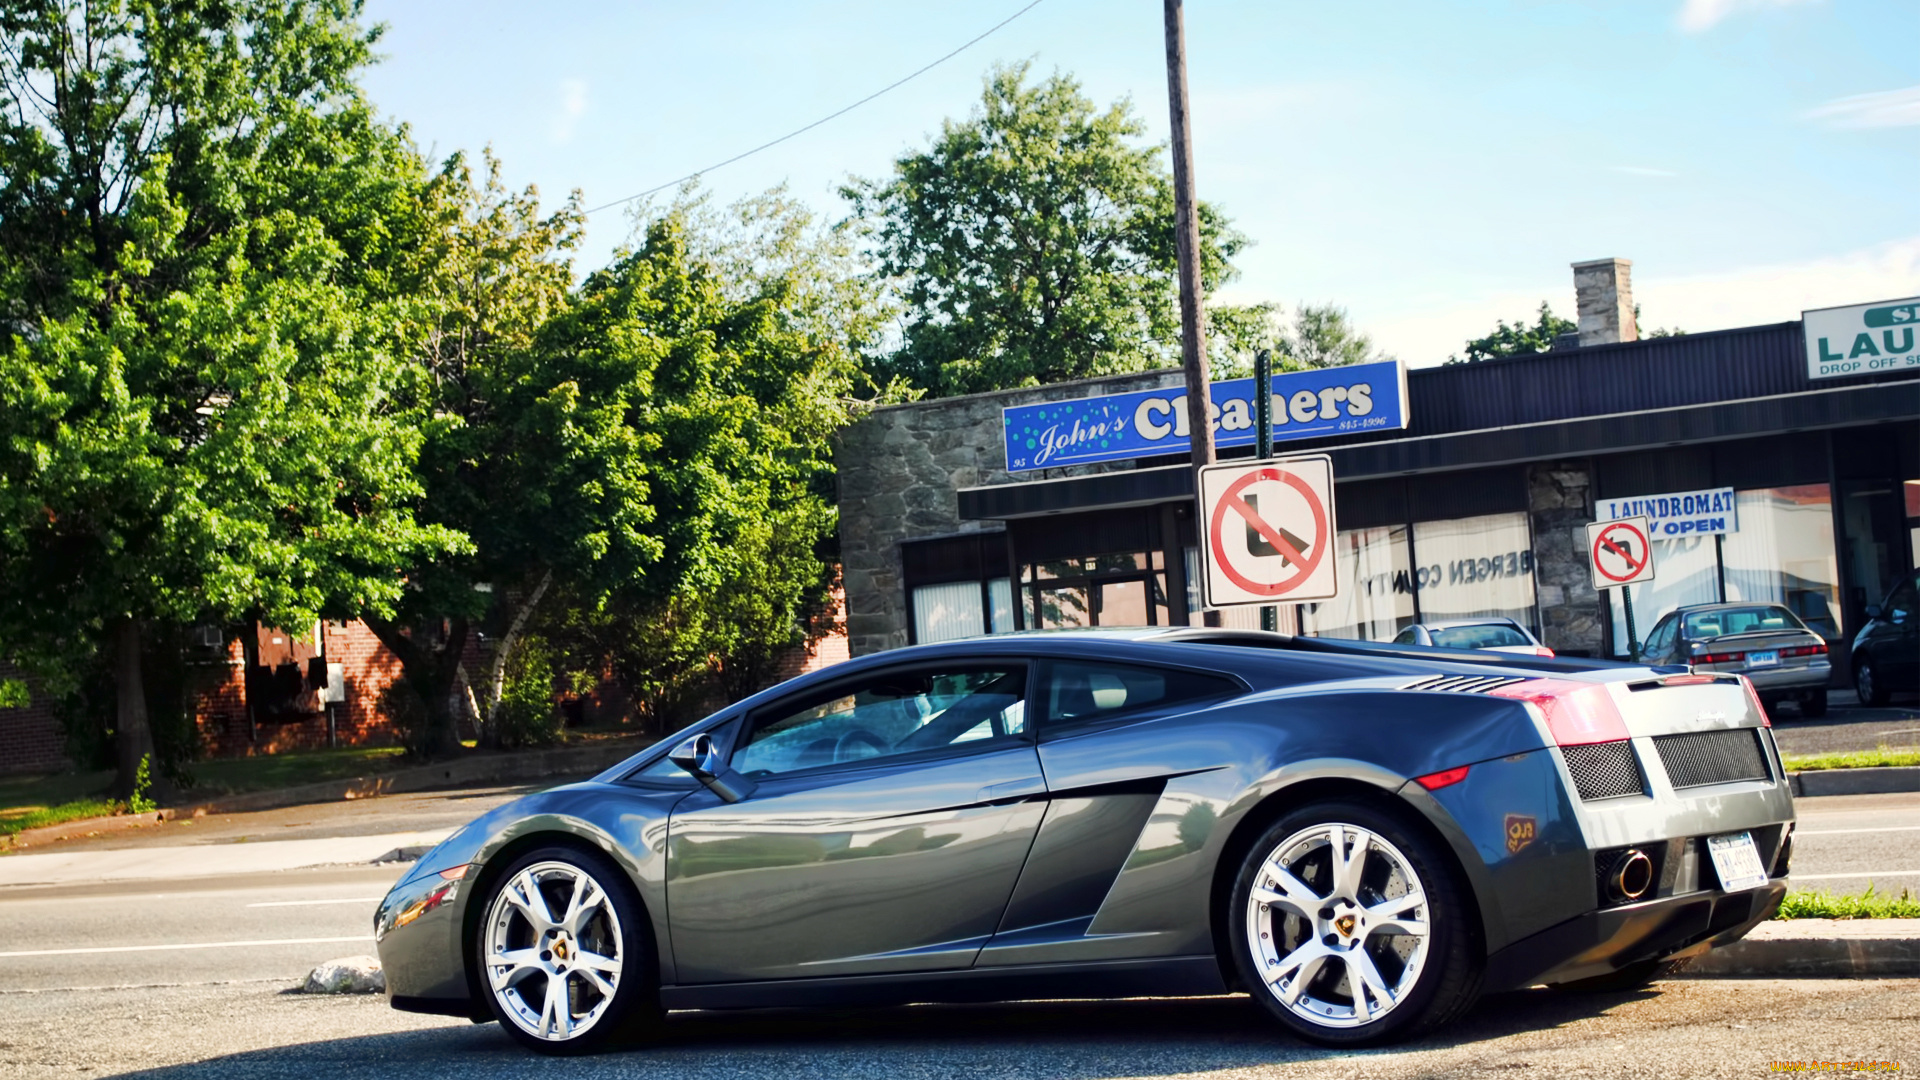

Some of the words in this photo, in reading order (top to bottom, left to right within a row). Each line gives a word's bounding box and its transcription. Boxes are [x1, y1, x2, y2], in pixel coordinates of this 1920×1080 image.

[1820, 361, 1861, 375] DROP
[1869, 357, 1897, 369] OFF
[1338, 416, 1387, 431] 845-4996
[1034, 406, 1130, 466] John's
[1013, 457, 1026, 468] 95
[1610, 491, 1733, 520] LAUNDROMAT
[1664, 517, 1725, 535] OPEN
